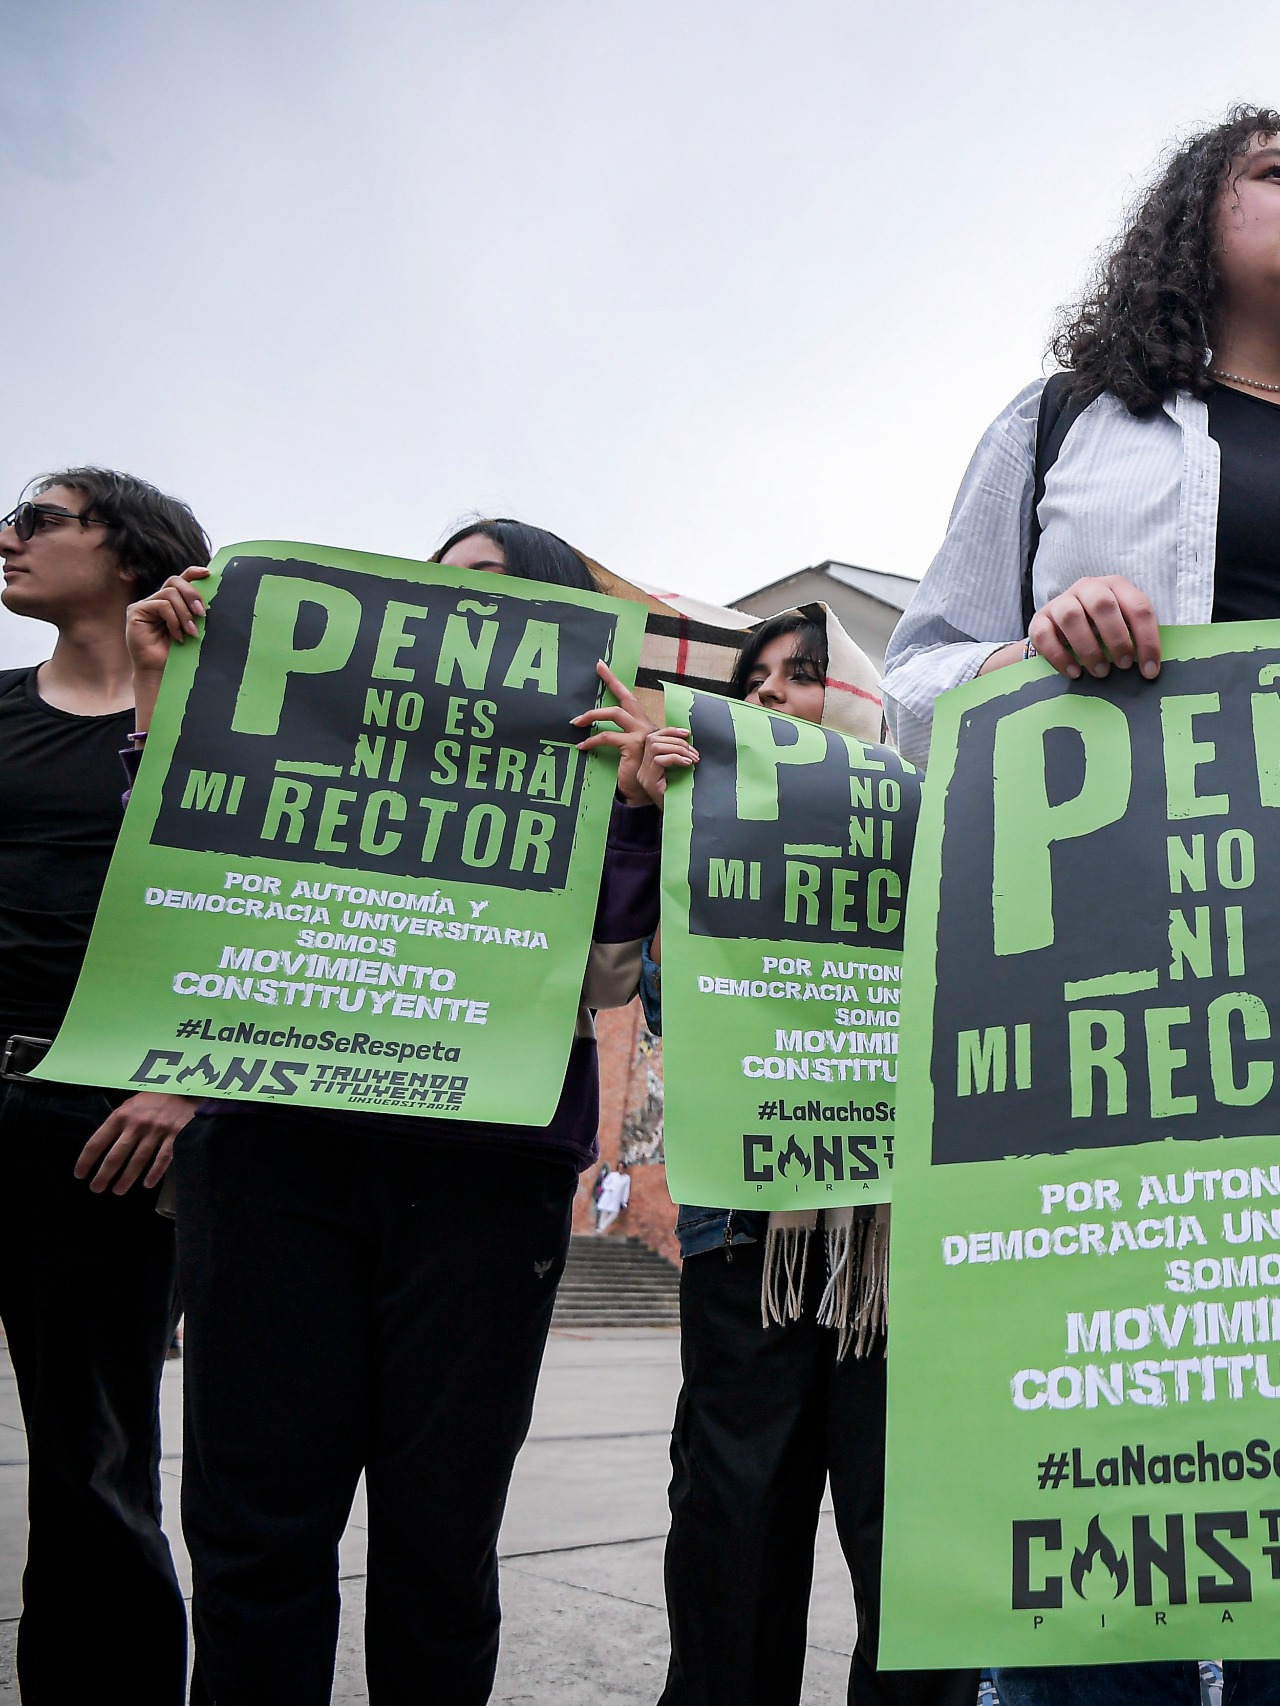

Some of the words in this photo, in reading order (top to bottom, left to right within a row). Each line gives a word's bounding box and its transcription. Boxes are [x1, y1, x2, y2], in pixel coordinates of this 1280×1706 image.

[231, 573, 562, 737] PEÑA
[363, 687, 424, 731] NO
[446, 697, 497, 737] ES
[350, 734, 407, 782] NI
[850, 776, 901, 812] NO
[180, 769, 245, 814] MI
[260, 778, 556, 874] RECTOR
[849, 816, 893, 860] NI
[1167, 829, 1255, 893] NO
[224, 872, 282, 895] POR
[291, 880, 455, 915] AUTONOMÍA
[470, 900, 489, 917] Y
[708, 858, 761, 900] MI
[784, 860, 901, 933] REC
[145, 887, 330, 924] DEMOCRACIA
[340, 910, 549, 950] UNIVERSITARIA
[296, 930, 396, 957] SOMOS
[1168, 906, 1243, 980] NI
[218, 946, 456, 992] MOVIMIENTO
[698, 976, 859, 1003] DEMOCRACIA
[762, 957, 812, 977] POR
[822, 960, 903, 981] AUTON
[172, 971, 489, 1025] CONSTITUYENTE
[835, 1008, 900, 1026] SOMO
[176, 1019, 461, 1063] #LaNachoSeRespeta
[775, 1029, 898, 1054] MOVIMI
[957, 1023, 1032, 1097] MI
[315, 1065, 469, 1090] TRUYENDO
[742, 1056, 897, 1082] CONSTITU
[309, 1080, 466, 1104] TITUYENTE
[348, 1096, 460, 1112] UNIVERSITARIA
[758, 1100, 895, 1121] #LaNachoSe
[1041, 1179, 1121, 1214] POR
[942, 1214, 1206, 1266] DEMOCRACIA
